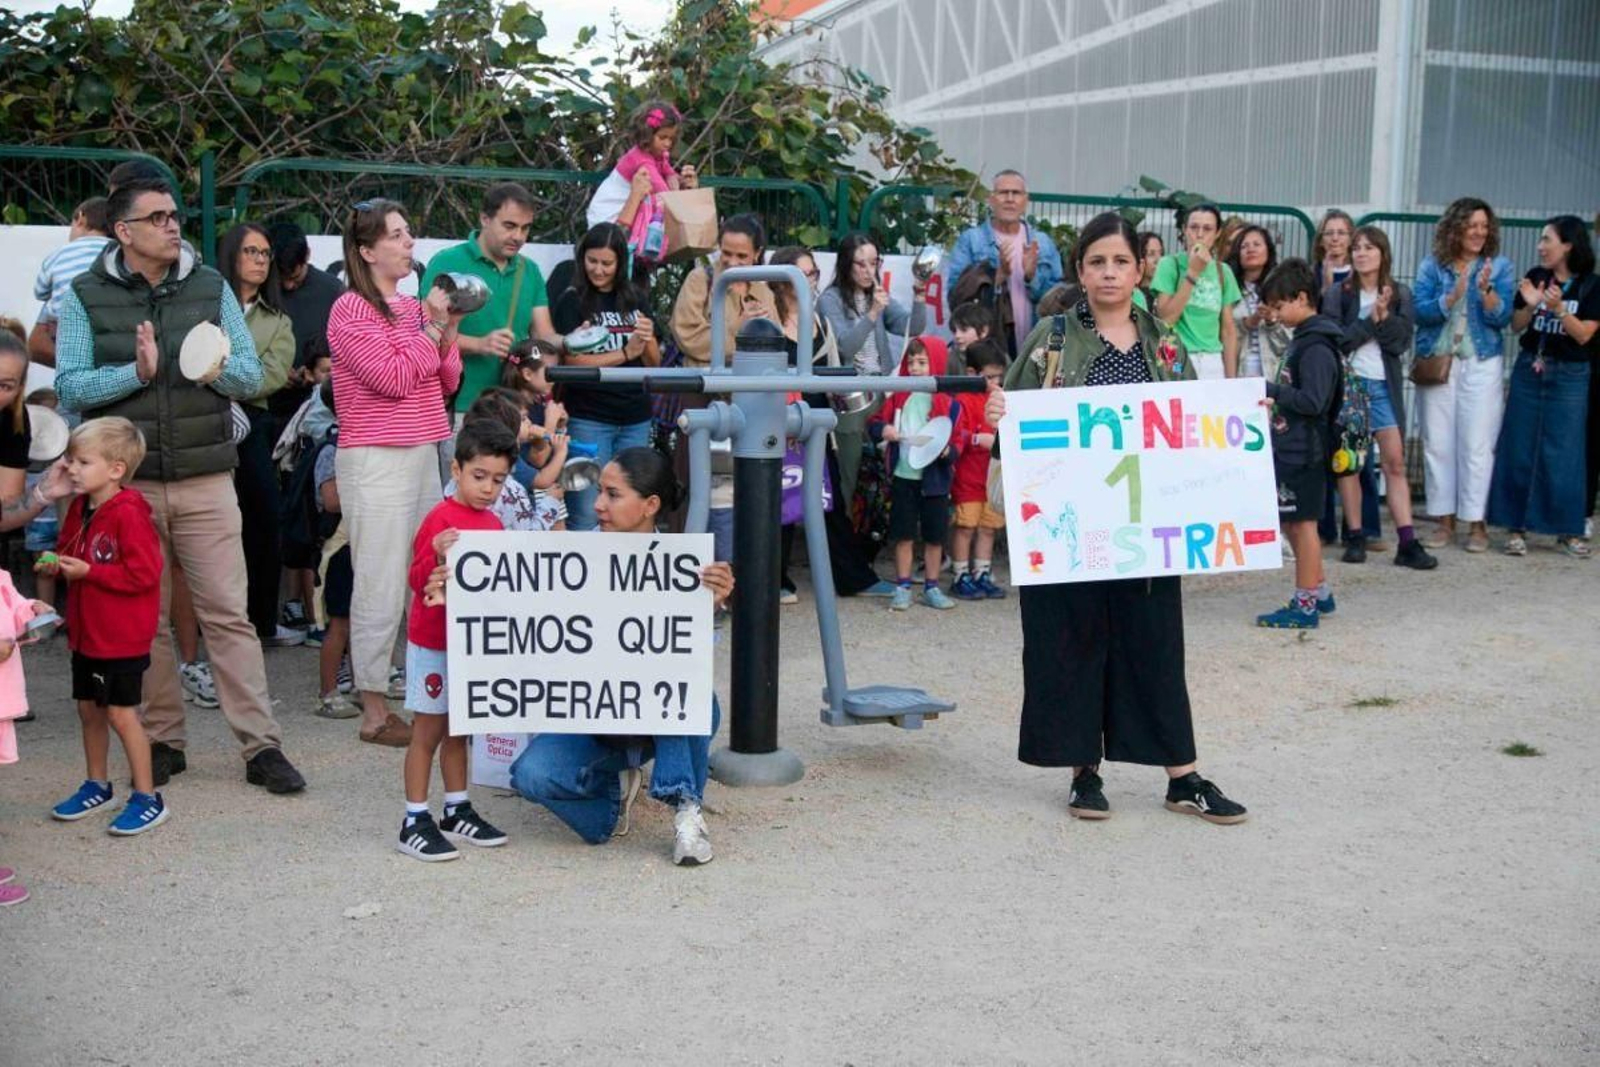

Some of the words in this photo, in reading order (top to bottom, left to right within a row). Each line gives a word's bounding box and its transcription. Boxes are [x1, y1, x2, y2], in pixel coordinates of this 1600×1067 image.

[1142, 399, 1265, 451] NENOS
[1105, 454, 1141, 523] 1
[455, 551, 588, 592] CANTO
[609, 541, 700, 592] MÁIS
[456, 615, 593, 655] TEMOS
[618, 616, 693, 655] QUE
[467, 678, 641, 720] ESPERAR
[654, 681, 688, 720] ?!
[486, 733, 517, 748] General
